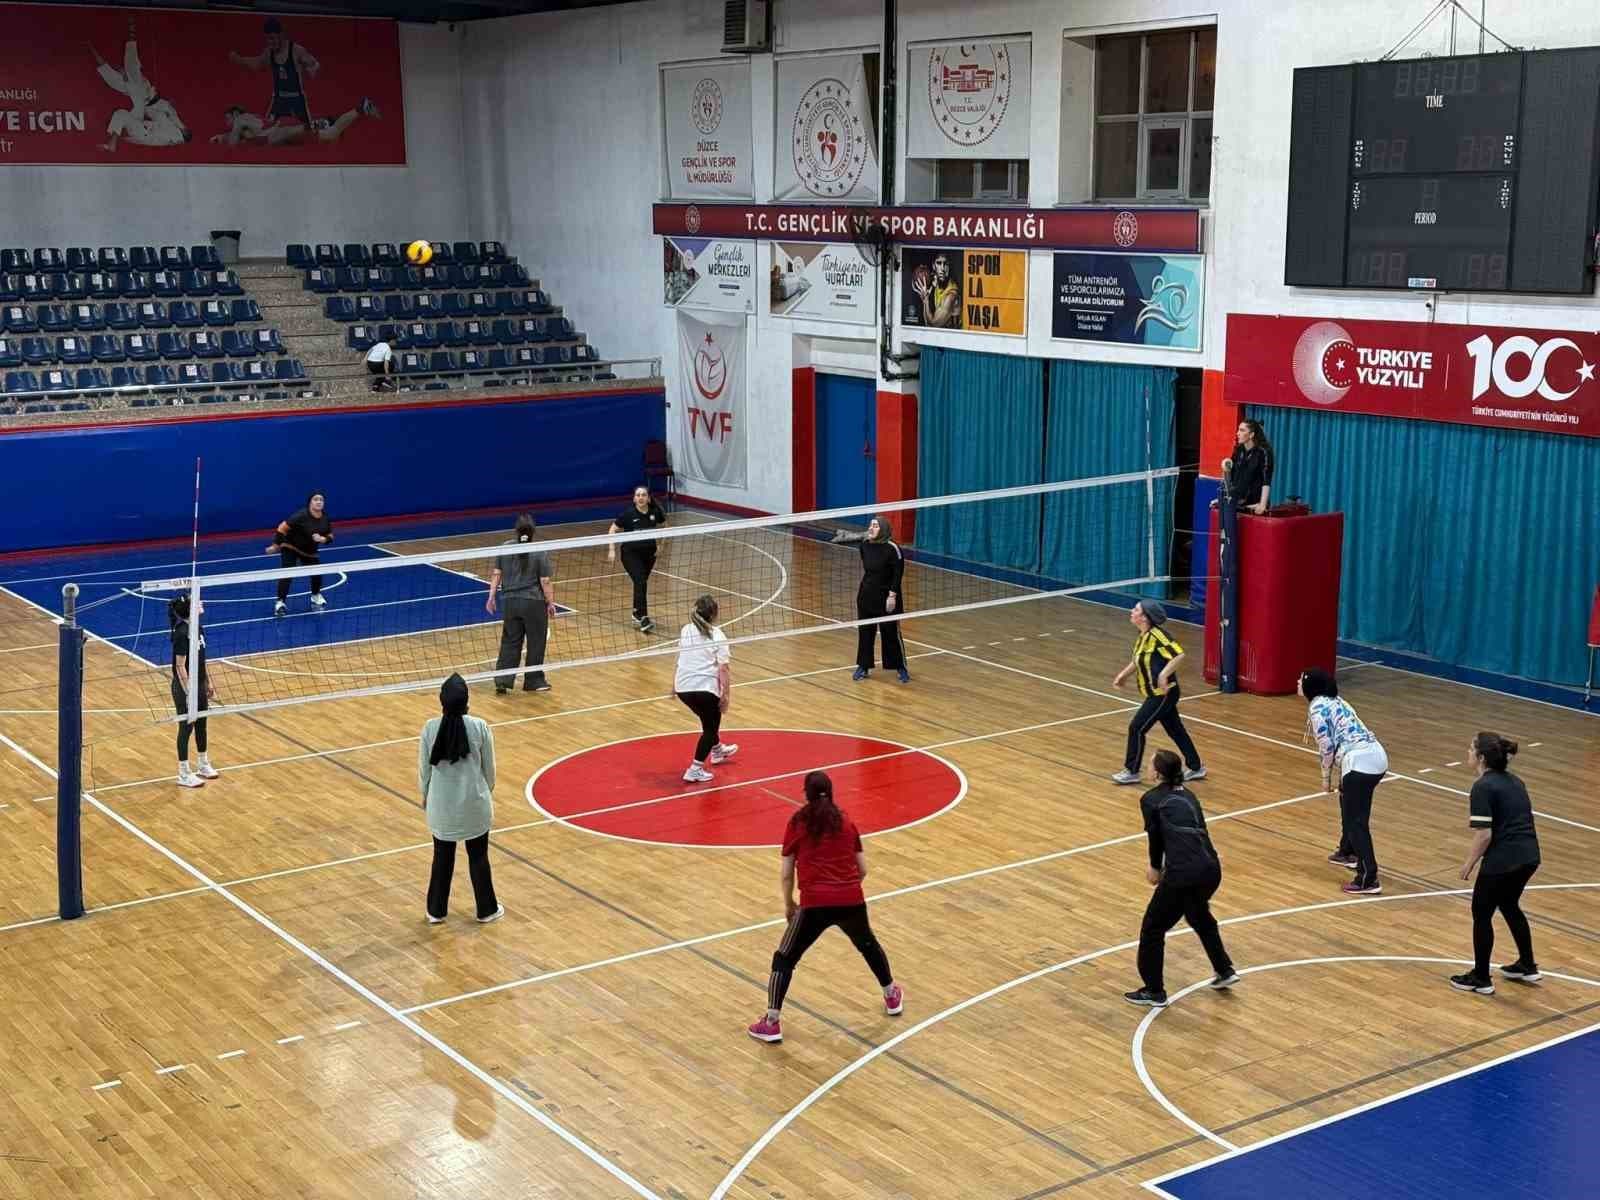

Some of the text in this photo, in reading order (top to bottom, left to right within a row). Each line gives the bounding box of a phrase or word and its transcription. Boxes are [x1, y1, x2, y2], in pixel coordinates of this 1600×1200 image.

[1425, 95, 1443, 108] TIME
[696, 139, 720, 152] DÜZCE
[681, 155, 736, 169] GENÇLİK VE SPOR
[693, 170, 733, 184] MÜDÜRLÜĞÜ
[745, 213, 772, 231] T.C.
[777, 210, 848, 236] GENÇLİK
[880, 215, 927, 236] SPOR
[933, 213, 1044, 240] BAKANLIĞI
[1414, 211, 1437, 225] PERIOD
[713, 242, 744, 264] Gençlik
[967, 254, 1000, 276] SPOR
[825, 273, 863, 287] YURTLARI
[1068, 274, 1118, 286] TÜM ANTRENÖR
[968, 277, 983, 298] LA
[1060, 285, 1126, 297] VE SPORCULARIMIZA
[1060, 295, 1092, 305] BAŞARILAR
[967, 304, 1000, 330] YAŞA
[1471, 404, 1494, 417] TÜRKİYE
[1542, 410, 1568, 423] YÜZÜNCÜ
[1568, 415, 1579, 425] YILI
[687, 406, 732, 444] TVF
